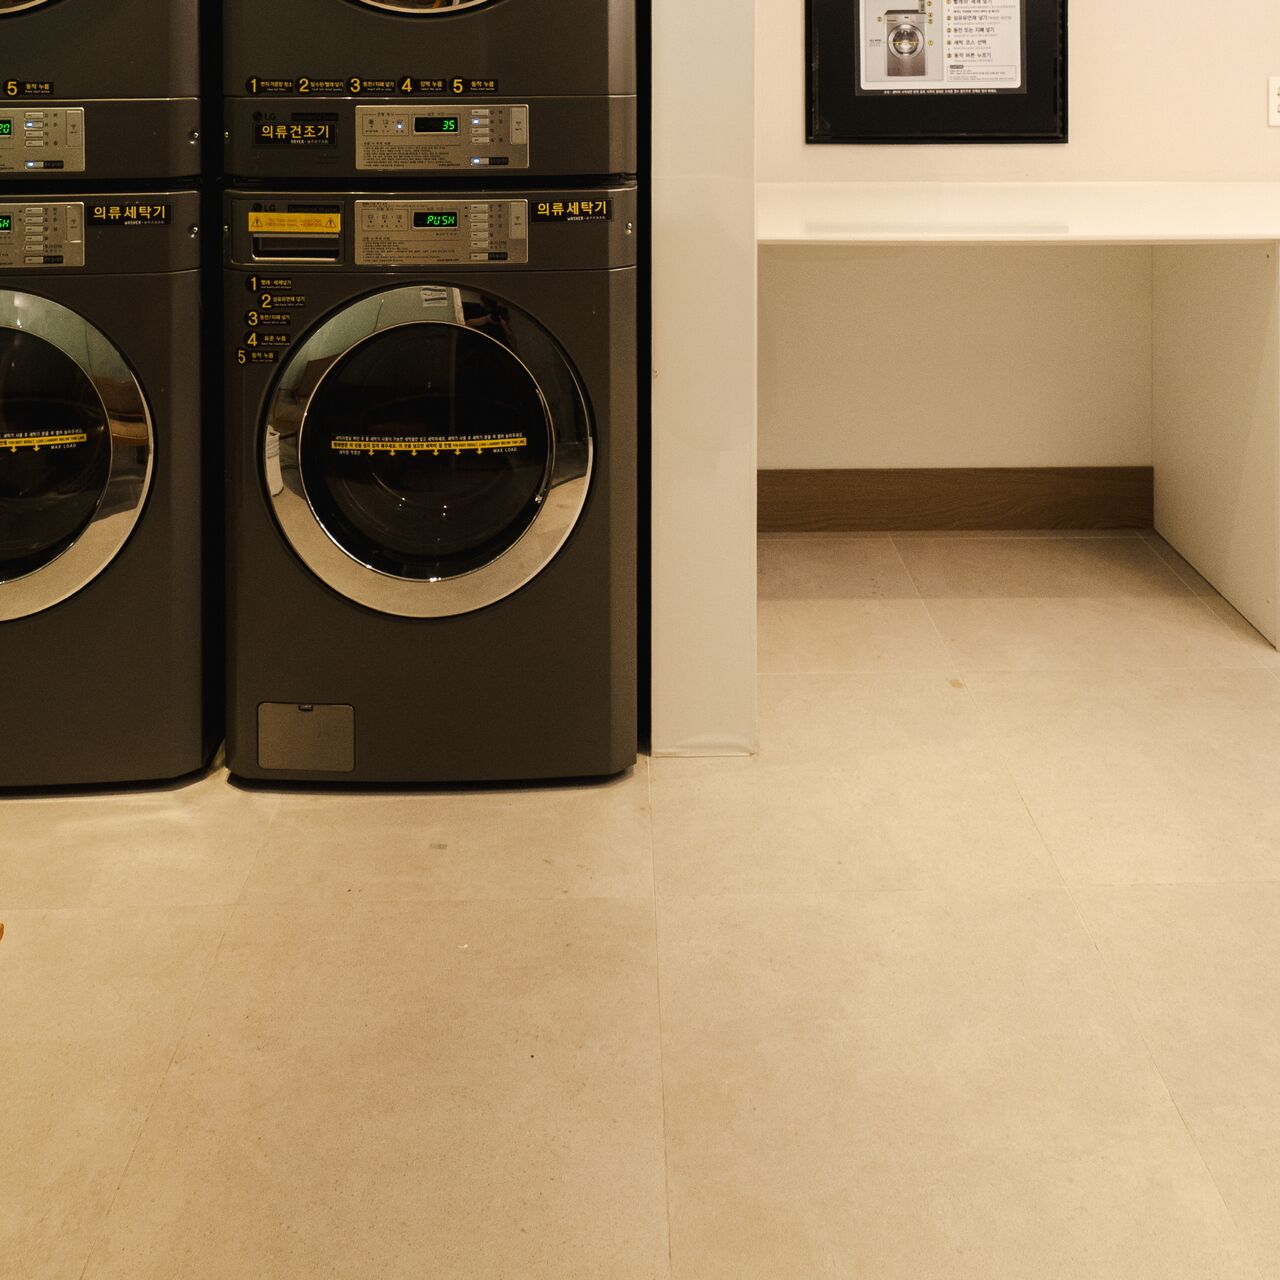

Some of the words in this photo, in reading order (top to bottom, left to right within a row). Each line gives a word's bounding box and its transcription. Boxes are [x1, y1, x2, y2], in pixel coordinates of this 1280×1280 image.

[7, 81, 16, 95] 5
[251, 79, 256, 93] 1
[299, 78, 309, 92] 2
[350, 78, 360, 92] 3
[401, 78, 412, 92] 4
[453, 80, 463, 93] 5
[265, 112, 276, 120] LG
[262, 125, 329, 138] 의류건조기
[442, 120, 455, 130] 35
[94, 206, 165, 219] 의류세탁기
[264, 204, 276, 212] LG
[537, 201, 606, 216] 의류세탁기
[427, 216, 455, 225] PUSH
[250, 277, 256, 291] 1
[261, 294, 271, 308] 2
[248, 311, 258, 325] 3
[247, 333, 258, 347] 4
[238, 350, 246, 364] 5
